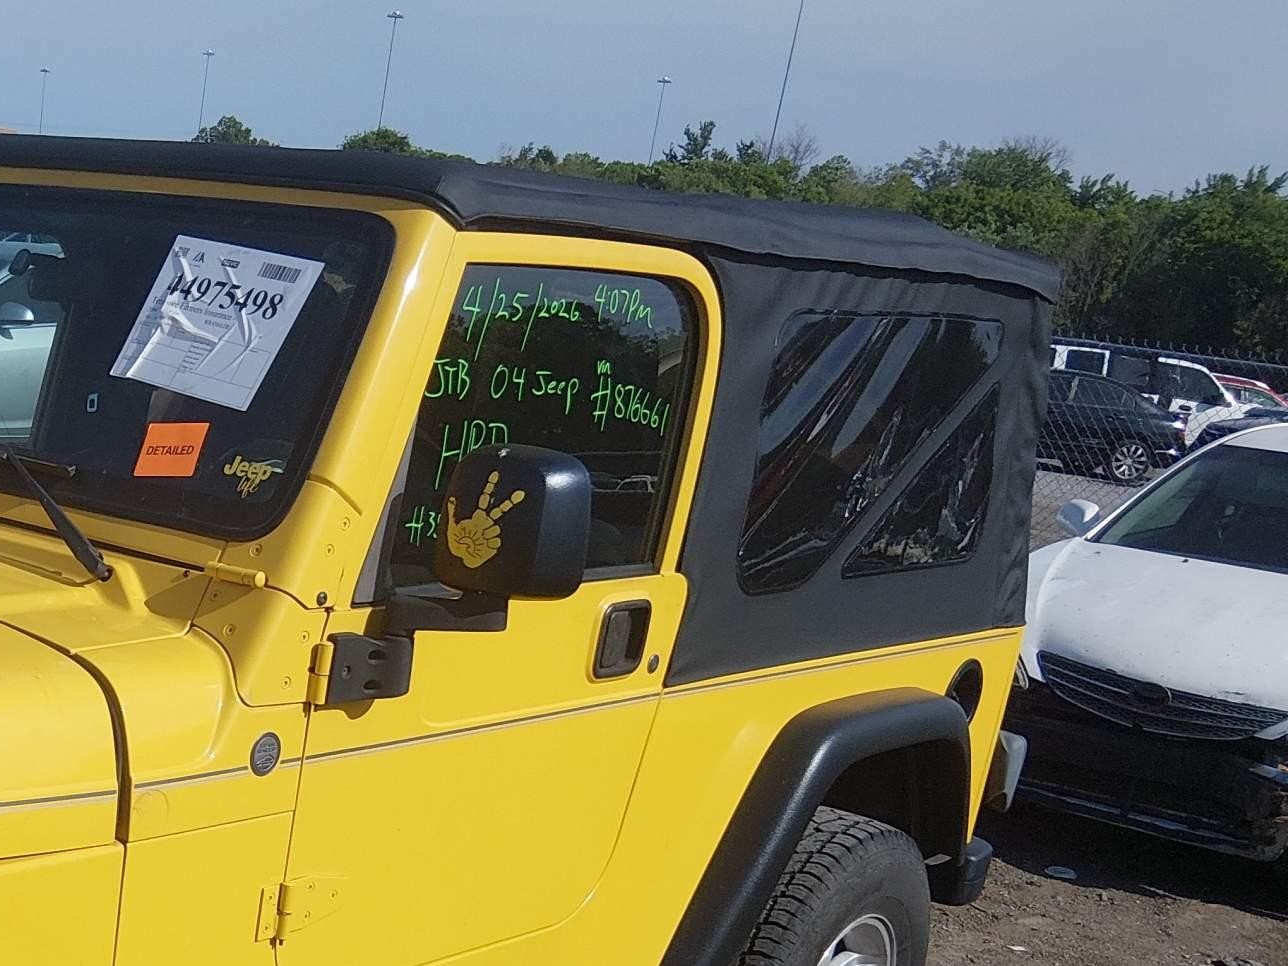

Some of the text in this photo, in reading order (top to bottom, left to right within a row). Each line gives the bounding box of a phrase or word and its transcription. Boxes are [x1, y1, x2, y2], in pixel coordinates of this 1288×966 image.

[167, 272, 284, 320] 44975498
[462, 277, 580, 362] 4/25/2026
[424, 359, 670, 437] JTB 04 Jeep #876661
[146, 445, 195, 456] DETAILED
[223, 455, 272, 483] Jeep
[405, 506, 442, 547] #3
